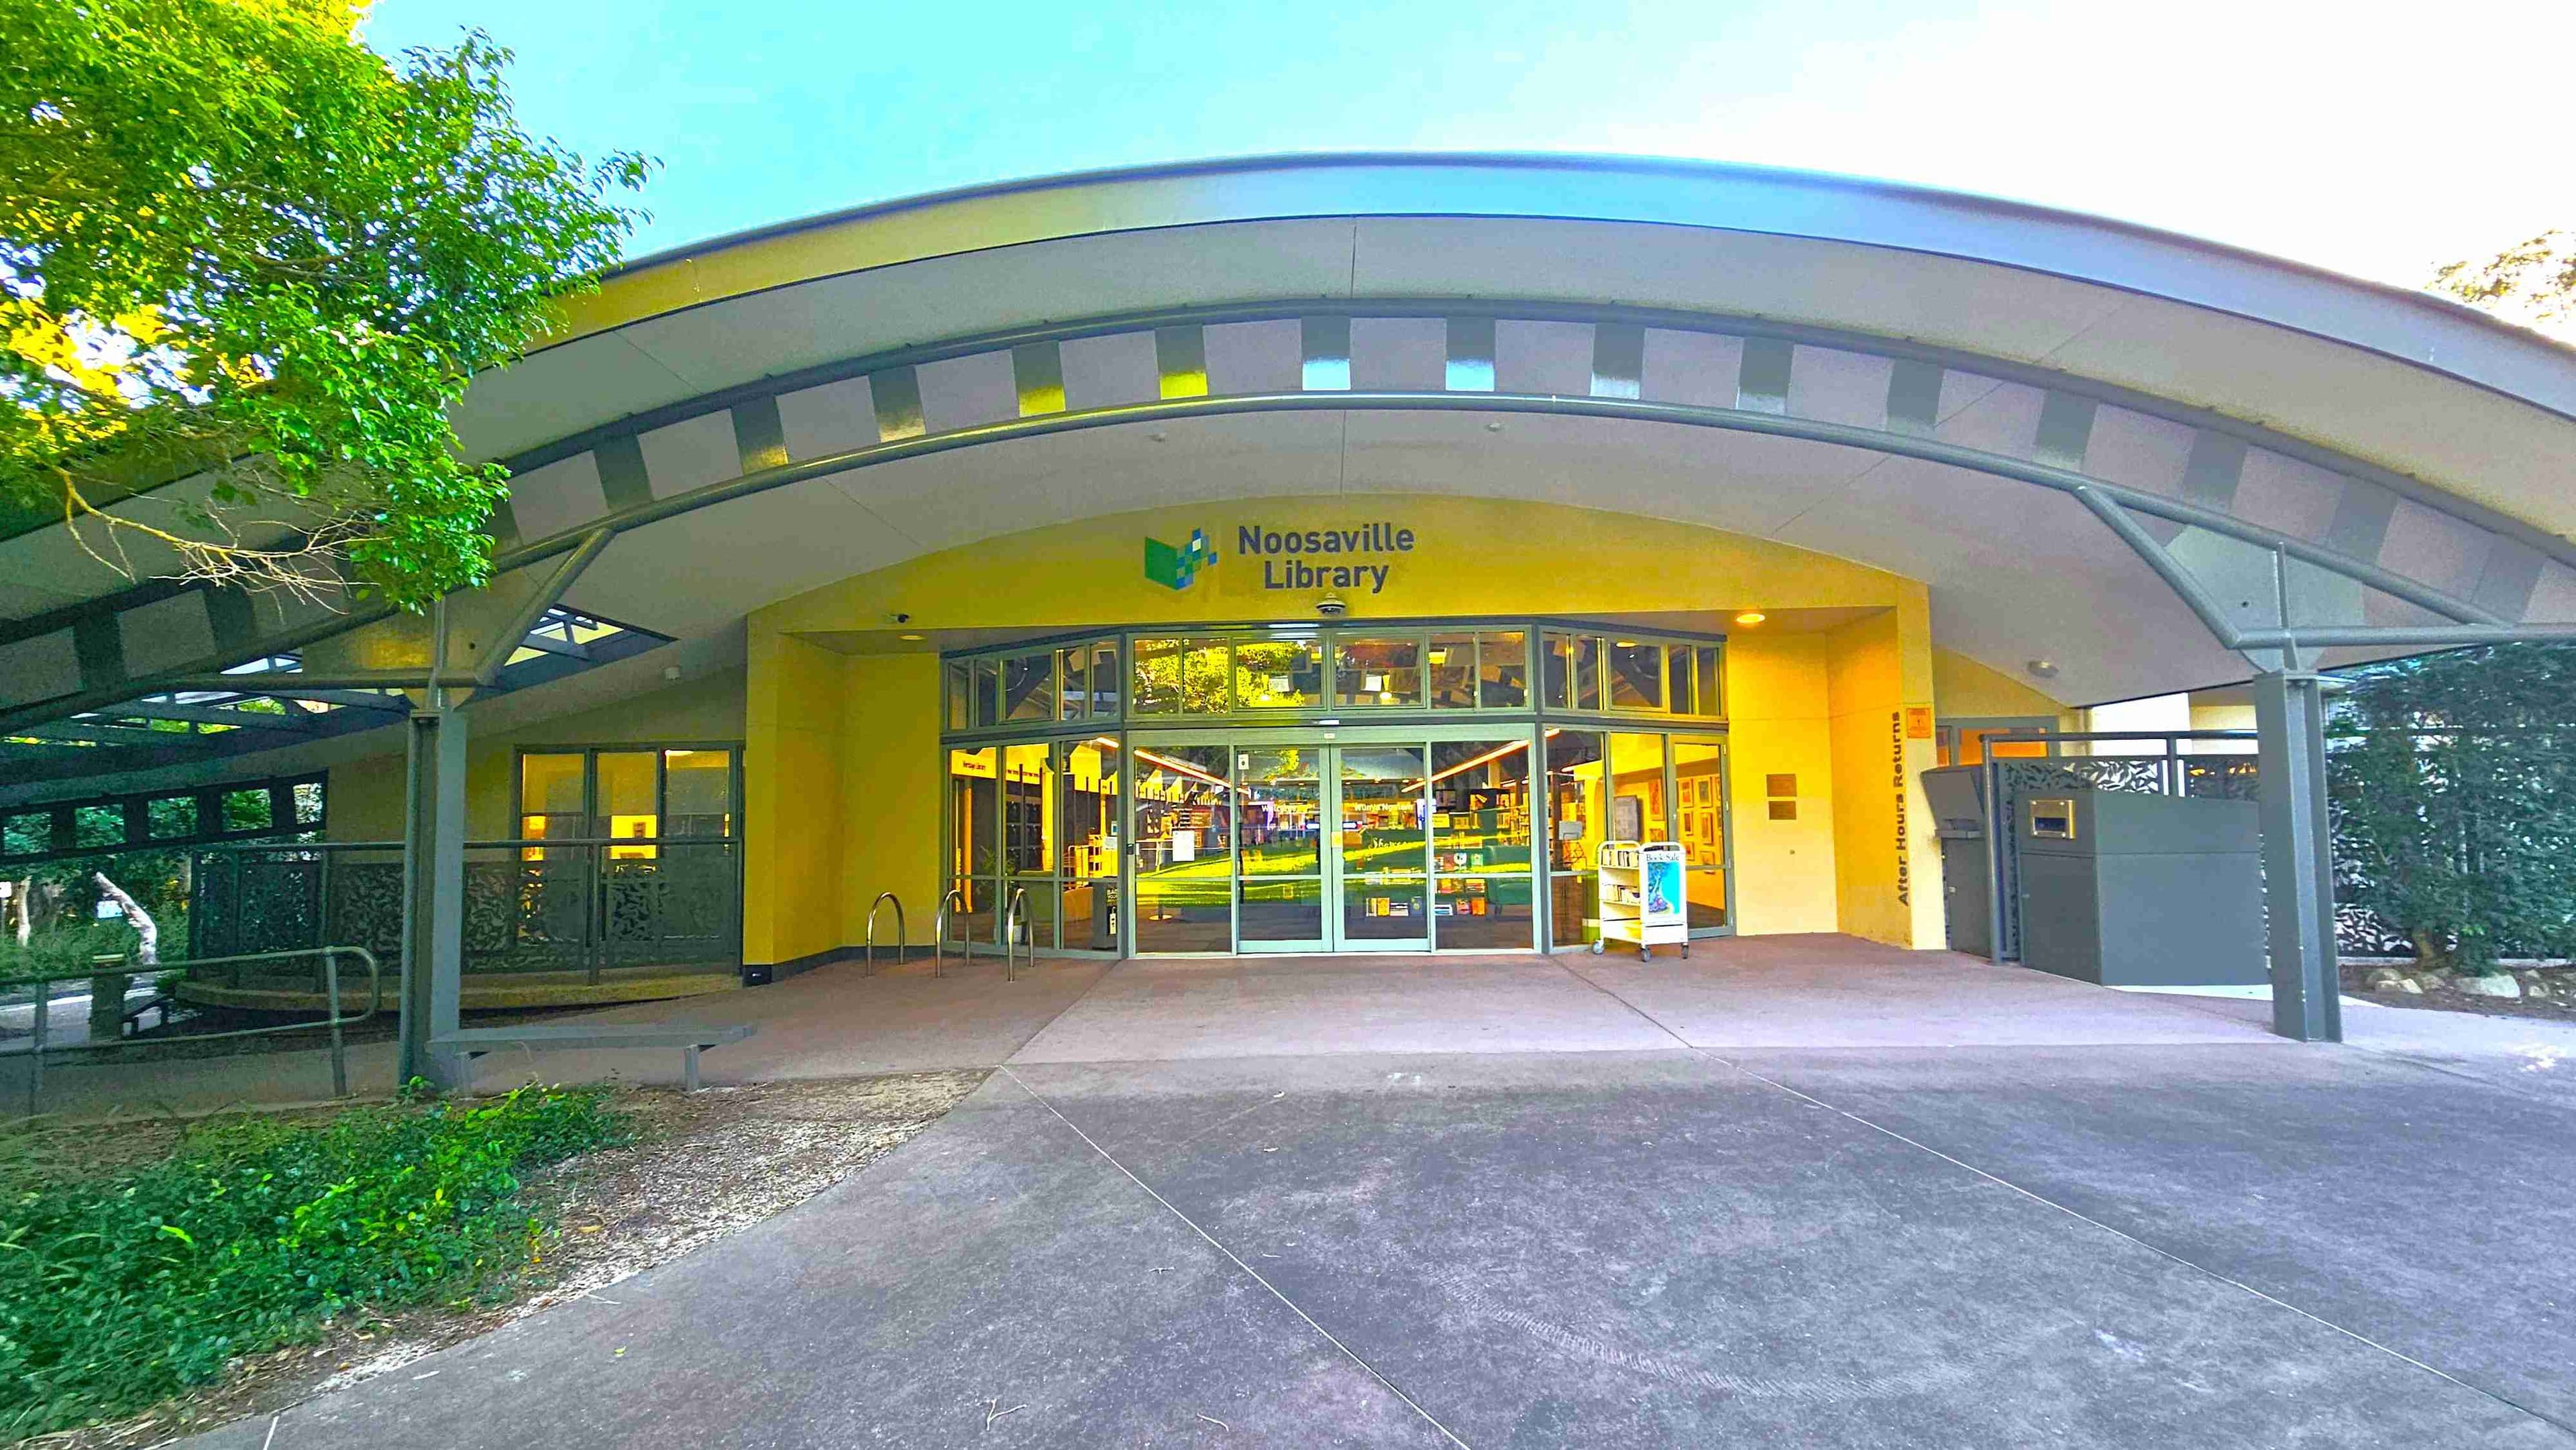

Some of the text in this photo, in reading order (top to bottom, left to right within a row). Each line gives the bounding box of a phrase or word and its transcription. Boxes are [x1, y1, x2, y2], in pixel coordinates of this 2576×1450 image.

[1239, 523, 1414, 554] Noosaville
[1265, 559, 1389, 594] Library
[1892, 712, 1909, 907] After Hours Returns
[1646, 852, 1679, 861] Book Sale
